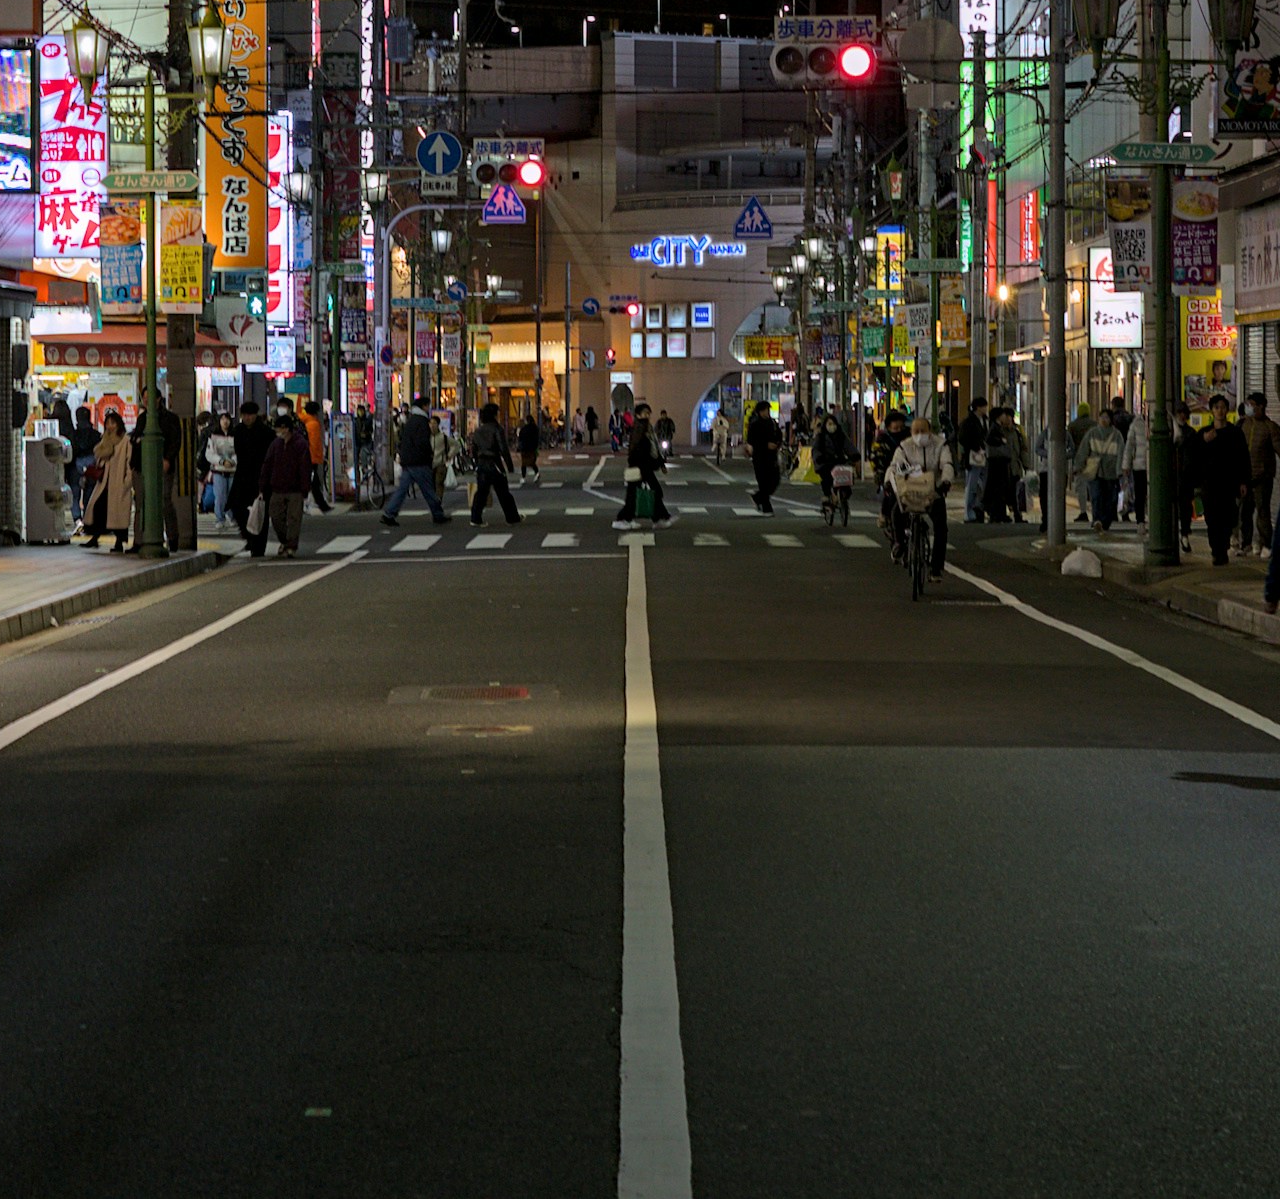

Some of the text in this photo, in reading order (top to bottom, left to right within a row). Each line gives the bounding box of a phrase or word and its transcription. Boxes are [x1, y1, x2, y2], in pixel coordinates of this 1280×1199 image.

[778, 19, 874, 39] 歩車分離式
[1124, 145, 1204, 161] なんさん通り
[113, 174, 187, 188] なんさん通り
[38, 187, 102, 232] 麻雀
[221, 175, 250, 257] なんば店
[651, 237, 708, 265] CITY
[1187, 314, 1237, 336] 出張
